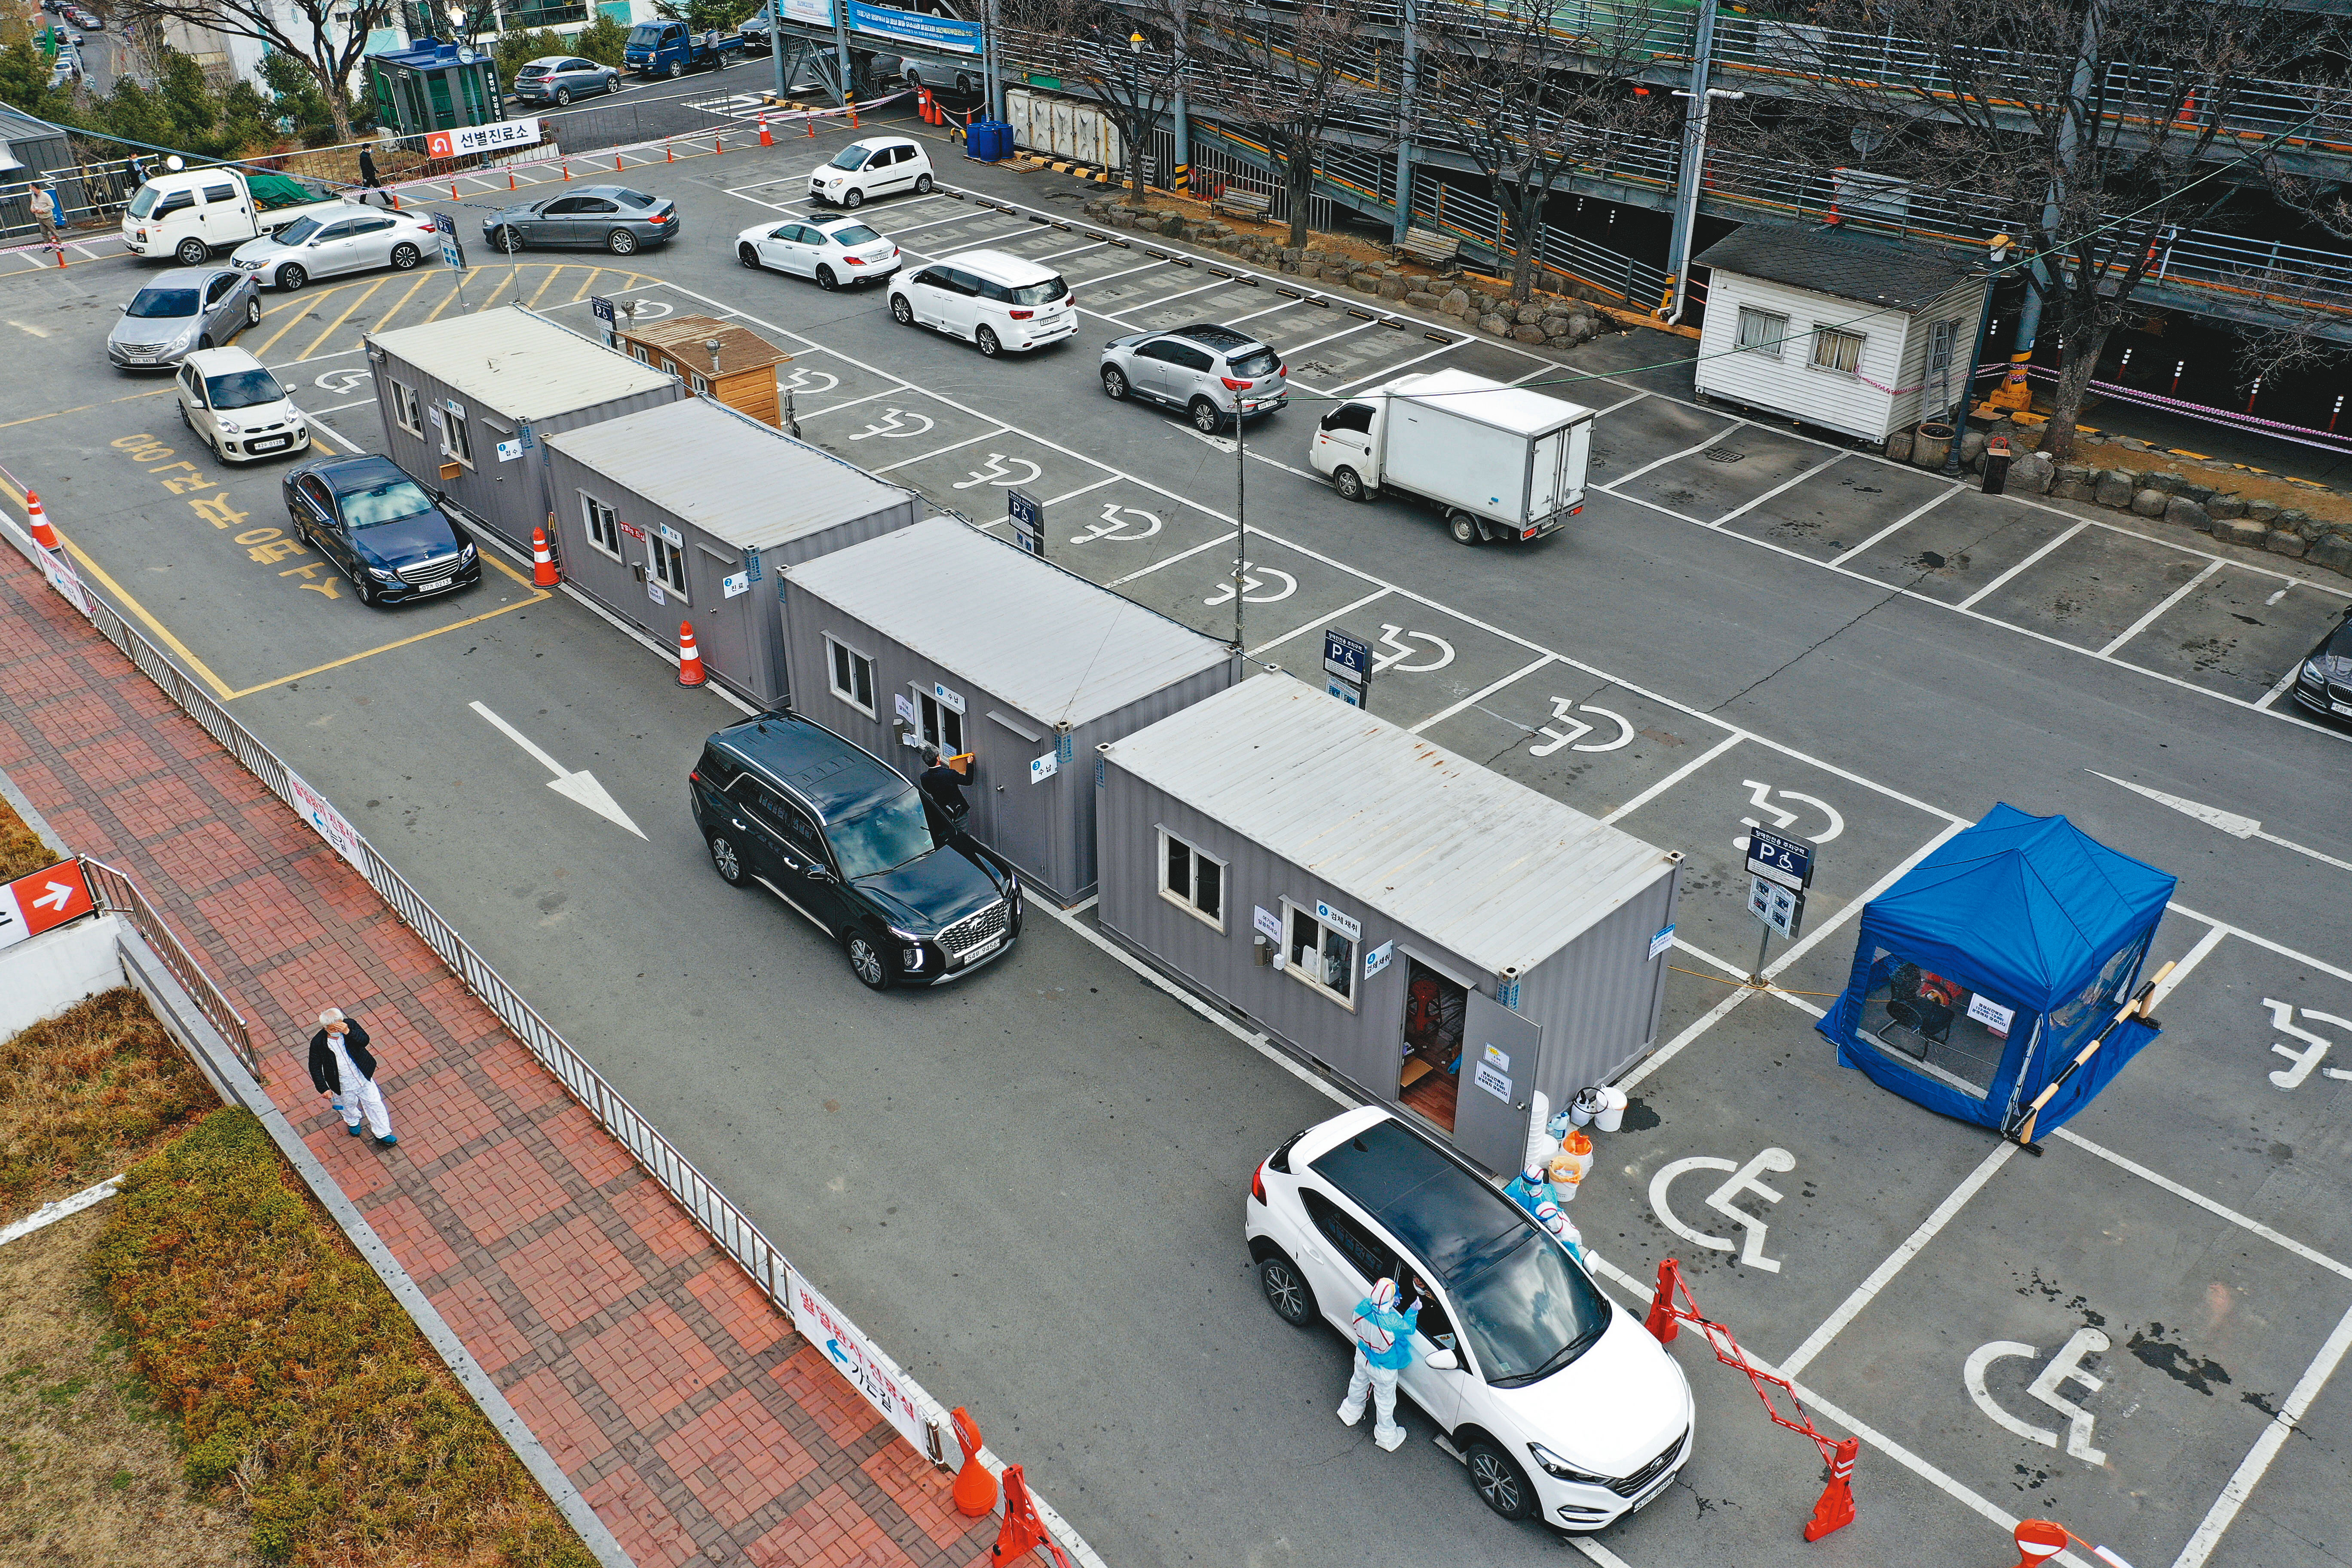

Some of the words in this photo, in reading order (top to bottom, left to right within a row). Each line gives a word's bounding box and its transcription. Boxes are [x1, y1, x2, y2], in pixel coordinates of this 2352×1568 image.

[487, 72, 496, 93] 금연이
[461, 125, 528, 148] 선별진료소
[438, 220, 443, 230] P
[596, 305, 601, 316] P
[1014, 501, 1020, 515] P
[435, 579, 449, 588] 0213
[731, 582, 744, 592] 진료
[1329, 632, 1346, 644] 장애인전용
[1347, 640, 1362, 651] 주차구역
[1332, 643, 1342, 658] P
[948, 693, 959, 704] 수납
[1038, 764, 1051, 776] 수납
[1755, 830, 1781, 845] 장애인전용
[1783, 841, 1805, 855] 주차구역
[1759, 842, 1775, 860] P
[1258, 918, 1278, 936] 말씀하세요
[1262, 915, 1274, 927] 여기에
[1331, 912, 1344, 925] 검체
[1344, 920, 1357, 933] 채취
[982, 942, 997, 953] 9456
[1366, 961, 1378, 974] 검체
[1378, 952, 1390, 965] 채취
[799, 1289, 862, 1364] 발열환자
[867, 1358, 916, 1423] 진료실
